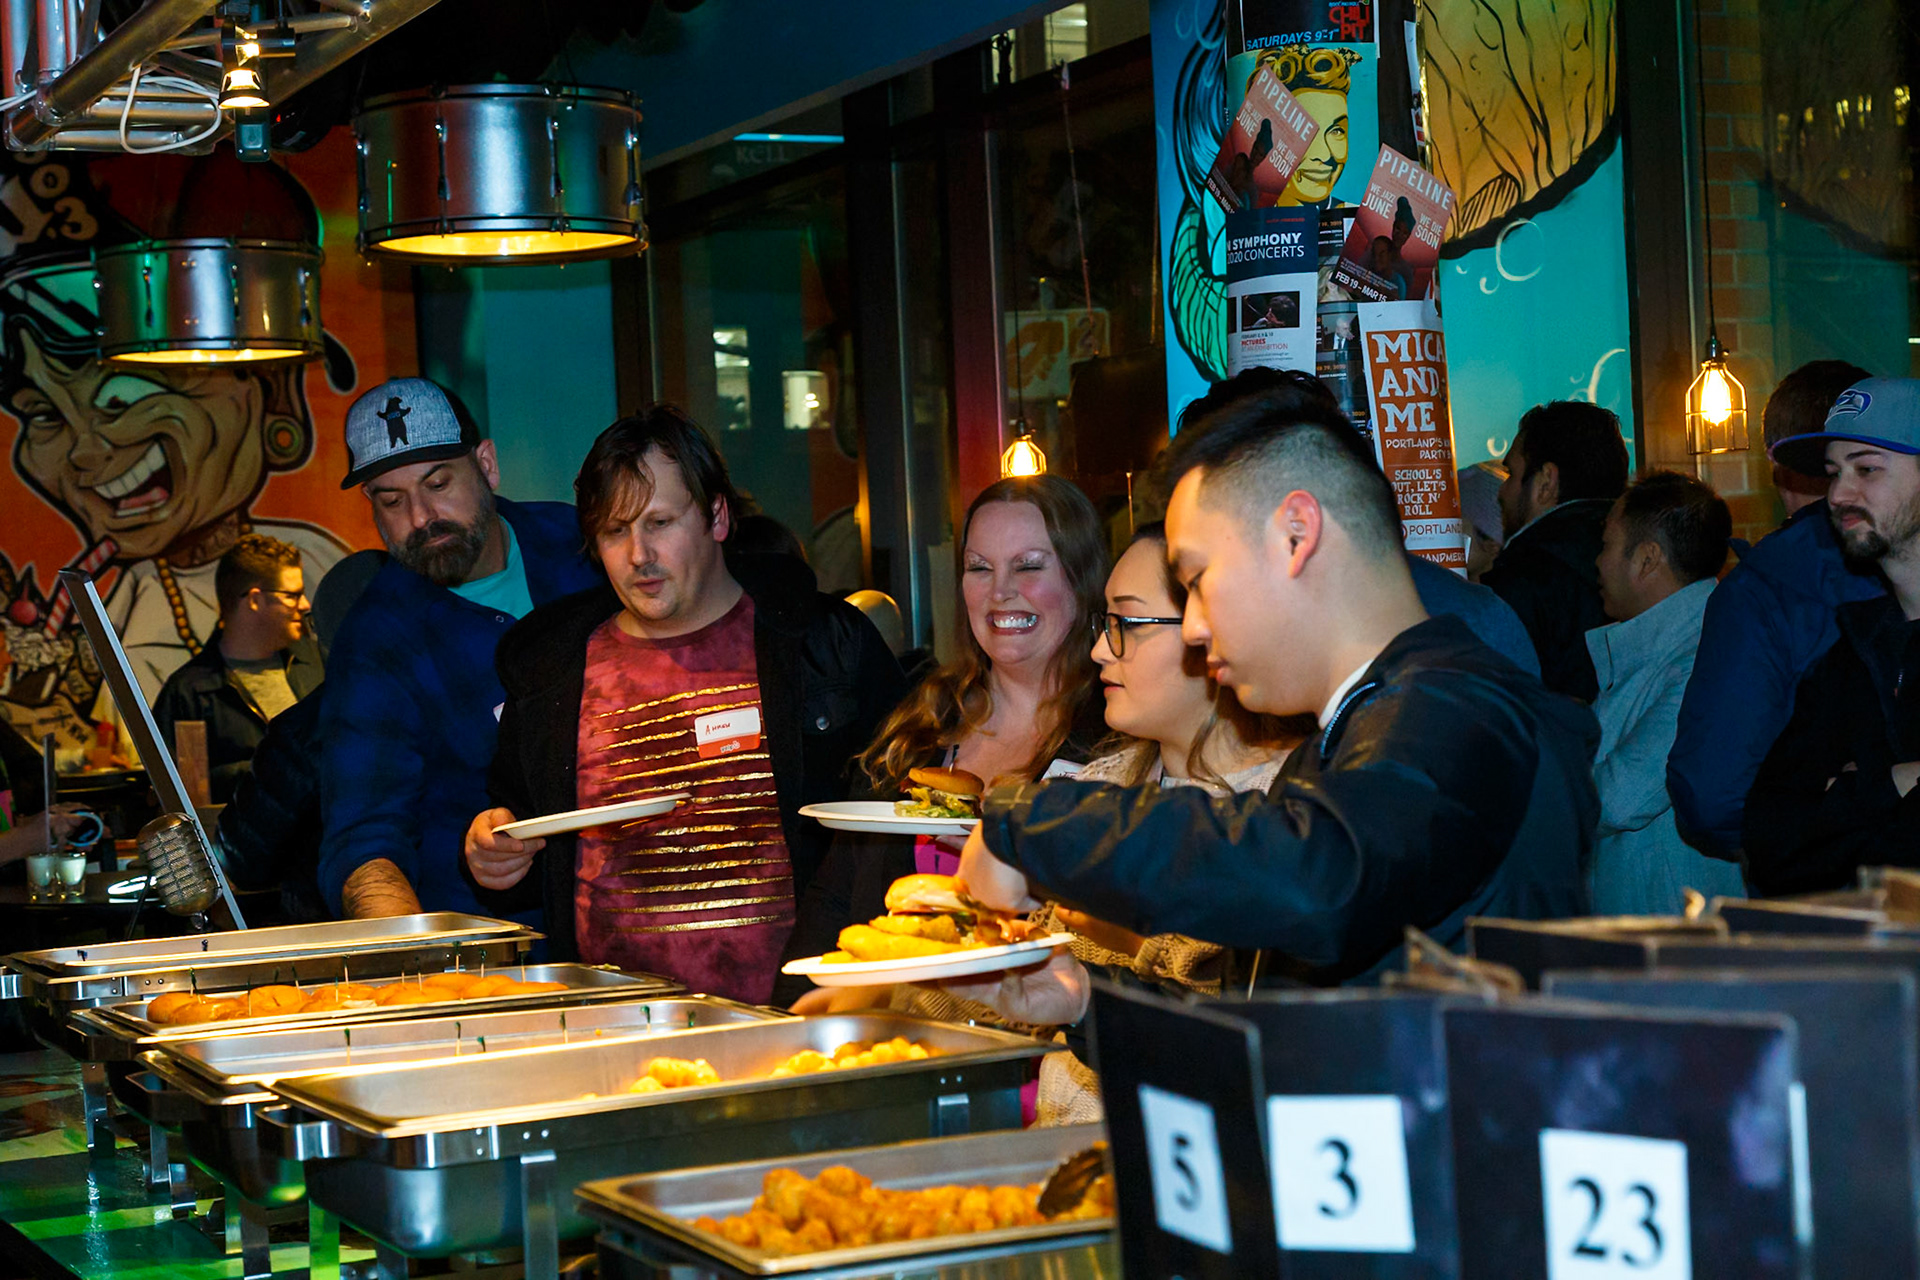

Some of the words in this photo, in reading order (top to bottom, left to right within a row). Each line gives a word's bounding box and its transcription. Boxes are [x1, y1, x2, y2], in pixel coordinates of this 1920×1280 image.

[1246, 31, 1312, 50] SATURDAYS
[1257, 69, 1313, 141] PIPELINE
[1236, 109, 1258, 137] JUNE
[1276, 139, 1287, 154] WE
[1269, 150, 1293, 178] SOON
[1379, 149, 1452, 211] PIPELINE
[1370, 183, 1383, 195] WE
[1380, 188, 1396, 204] JAZZ
[1362, 194, 1394, 219] JUNE
[1419, 213, 1432, 227] WE
[1430, 219, 1443, 237] DIE
[1232, 232, 1302, 250] SYMPHONY
[1415, 225, 1440, 250] SOON
[1244, 245, 1305, 261] CONCERTS
[1335, 271, 1350, 285] FEB
[1350, 278, 1359, 289] 19
[1361, 285, 1379, 300] MAR
[1378, 366, 1440, 398] AND
[1380, 401, 1437, 433] ME
[1385, 437, 1444, 449] PORTLAND'S
[1419, 449, 1447, 460] PARTY
[1395, 468, 1442, 480] SCHOOL'S
[1416, 480, 1447, 492] LET'S
[1397, 492, 1425, 505] ROCK
[1428, 492, 1441, 503] N'
[1404, 504, 1433, 516] ROLL
[1171, 1131, 1200, 1211] 5
[1313, 1136, 1361, 1219] 3
[1568, 1177, 1665, 1269] 23
